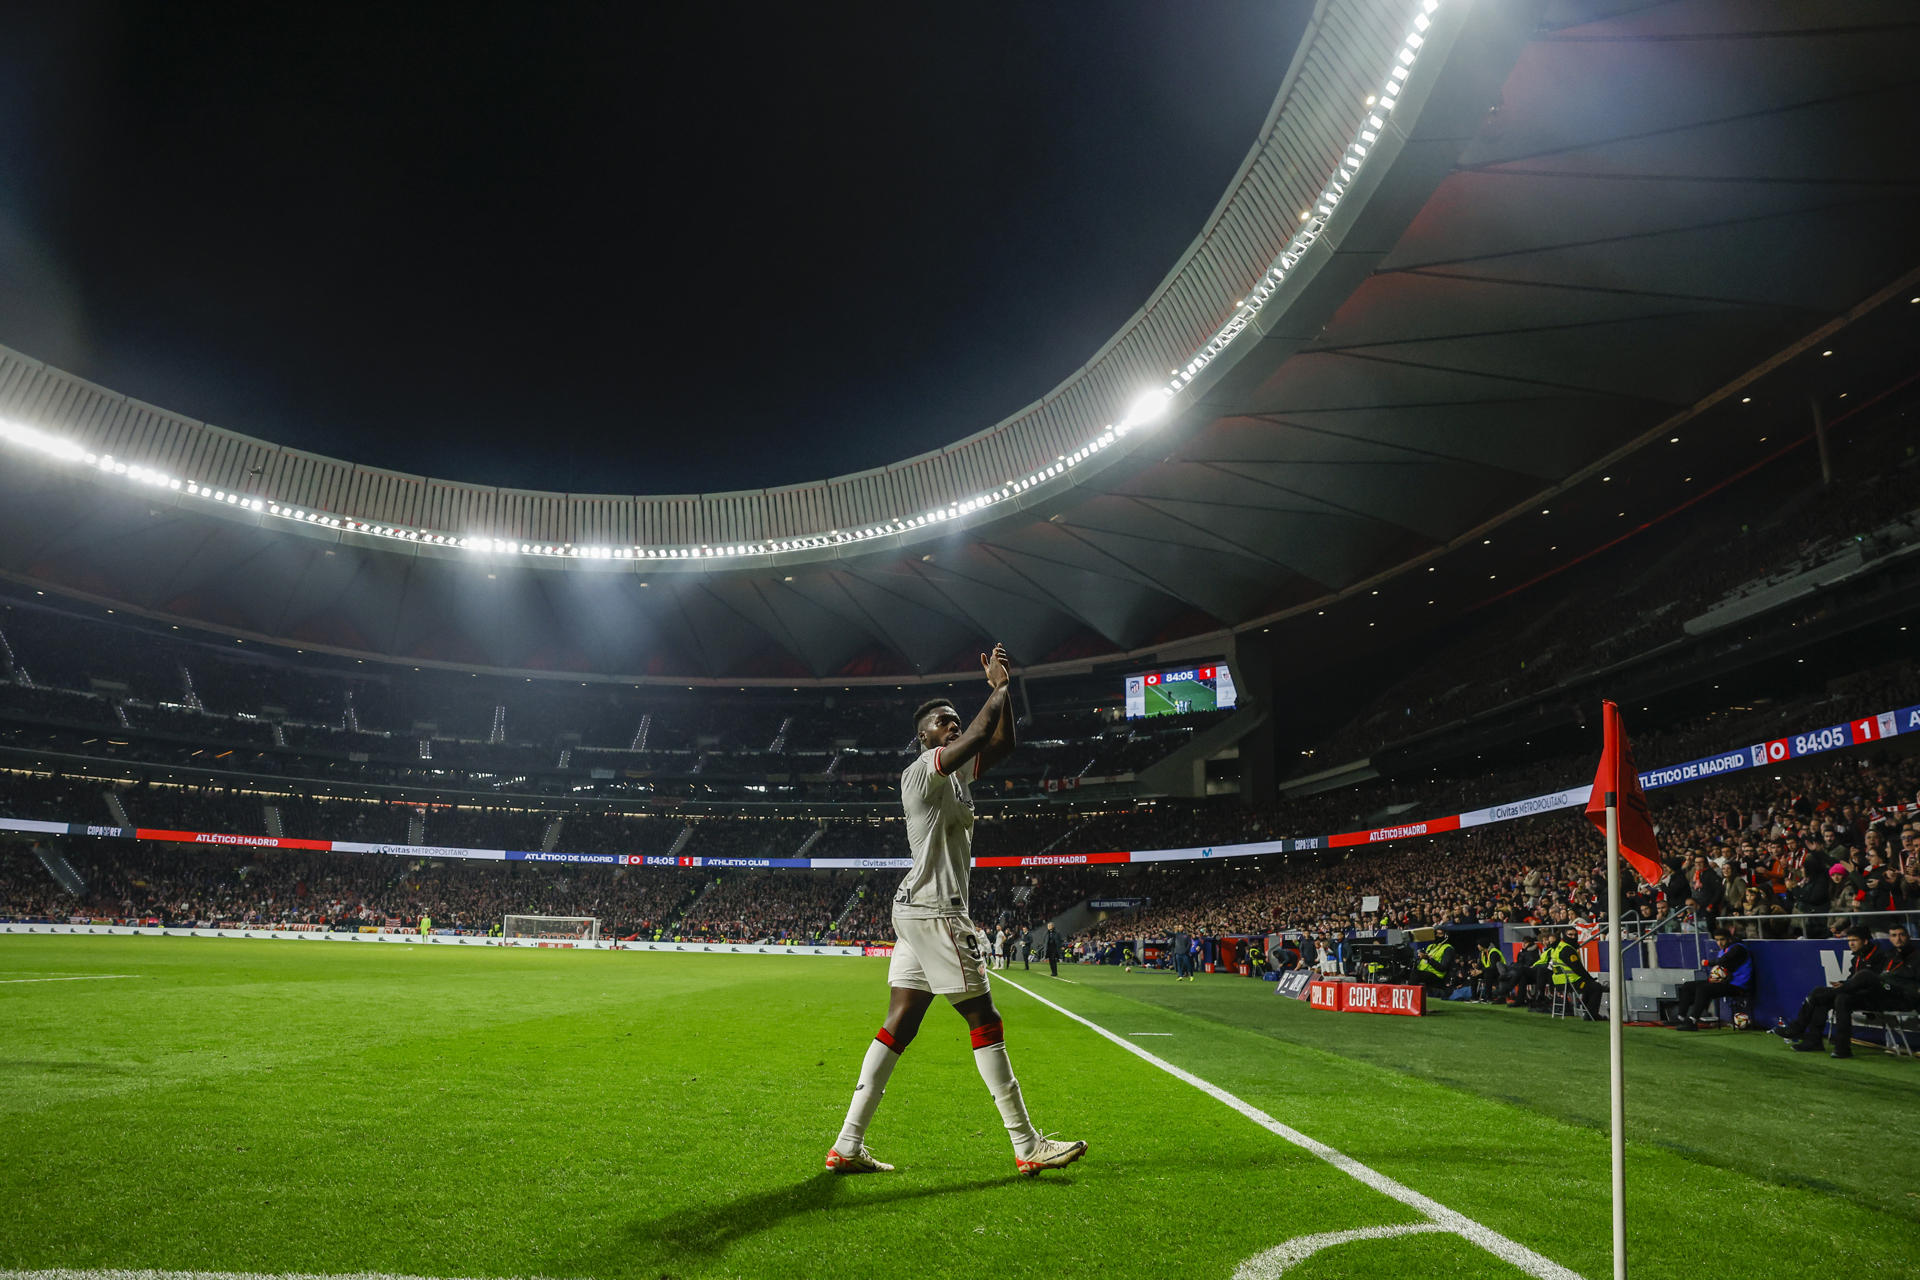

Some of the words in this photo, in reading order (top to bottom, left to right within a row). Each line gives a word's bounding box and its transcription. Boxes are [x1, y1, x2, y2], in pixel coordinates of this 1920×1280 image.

[1147, 676, 1157, 684] 0
[1166, 671, 1193, 682] 84:05
[1205, 668, 1211, 677] 1
[1639, 772, 1682, 788] TLÉTICO
[1683, 764, 1698, 779] DE
[1698, 754, 1744, 775] MADRID
[1770, 742, 1785, 759] 0
[1796, 727, 1844, 754] 84:05
[1860, 721, 1872, 739] 1
[1496, 807, 1518, 818] Civitas
[1519, 794, 1568, 815] METROPOLITANO
[87, 825, 103, 836] COPA
[110, 827, 121, 837] REY
[1370, 828, 1398, 842] ATLÉTICO
[1403, 824, 1427, 836] MADRID
[196, 833, 236, 843] ATLÉTICO
[244, 837, 278, 846] MADRID
[1295, 840, 1306, 850] COPA
[1310, 838, 1318, 849] REY
[382, 846, 410, 854] Civitas
[411, 848, 468, 856] METROPOLITANO
[525, 853, 567, 861] ATLÉTICO
[630, 856, 640, 864] 0
[647, 857, 675, 865] 84:05
[1021, 856, 1053, 865] ATLÉTICO
[1059, 855, 1087, 863] MADRID
[966, 934, 980, 959] 9
[1349, 986, 1377, 1008] COPA
[1392, 988, 1413, 1009] REY
